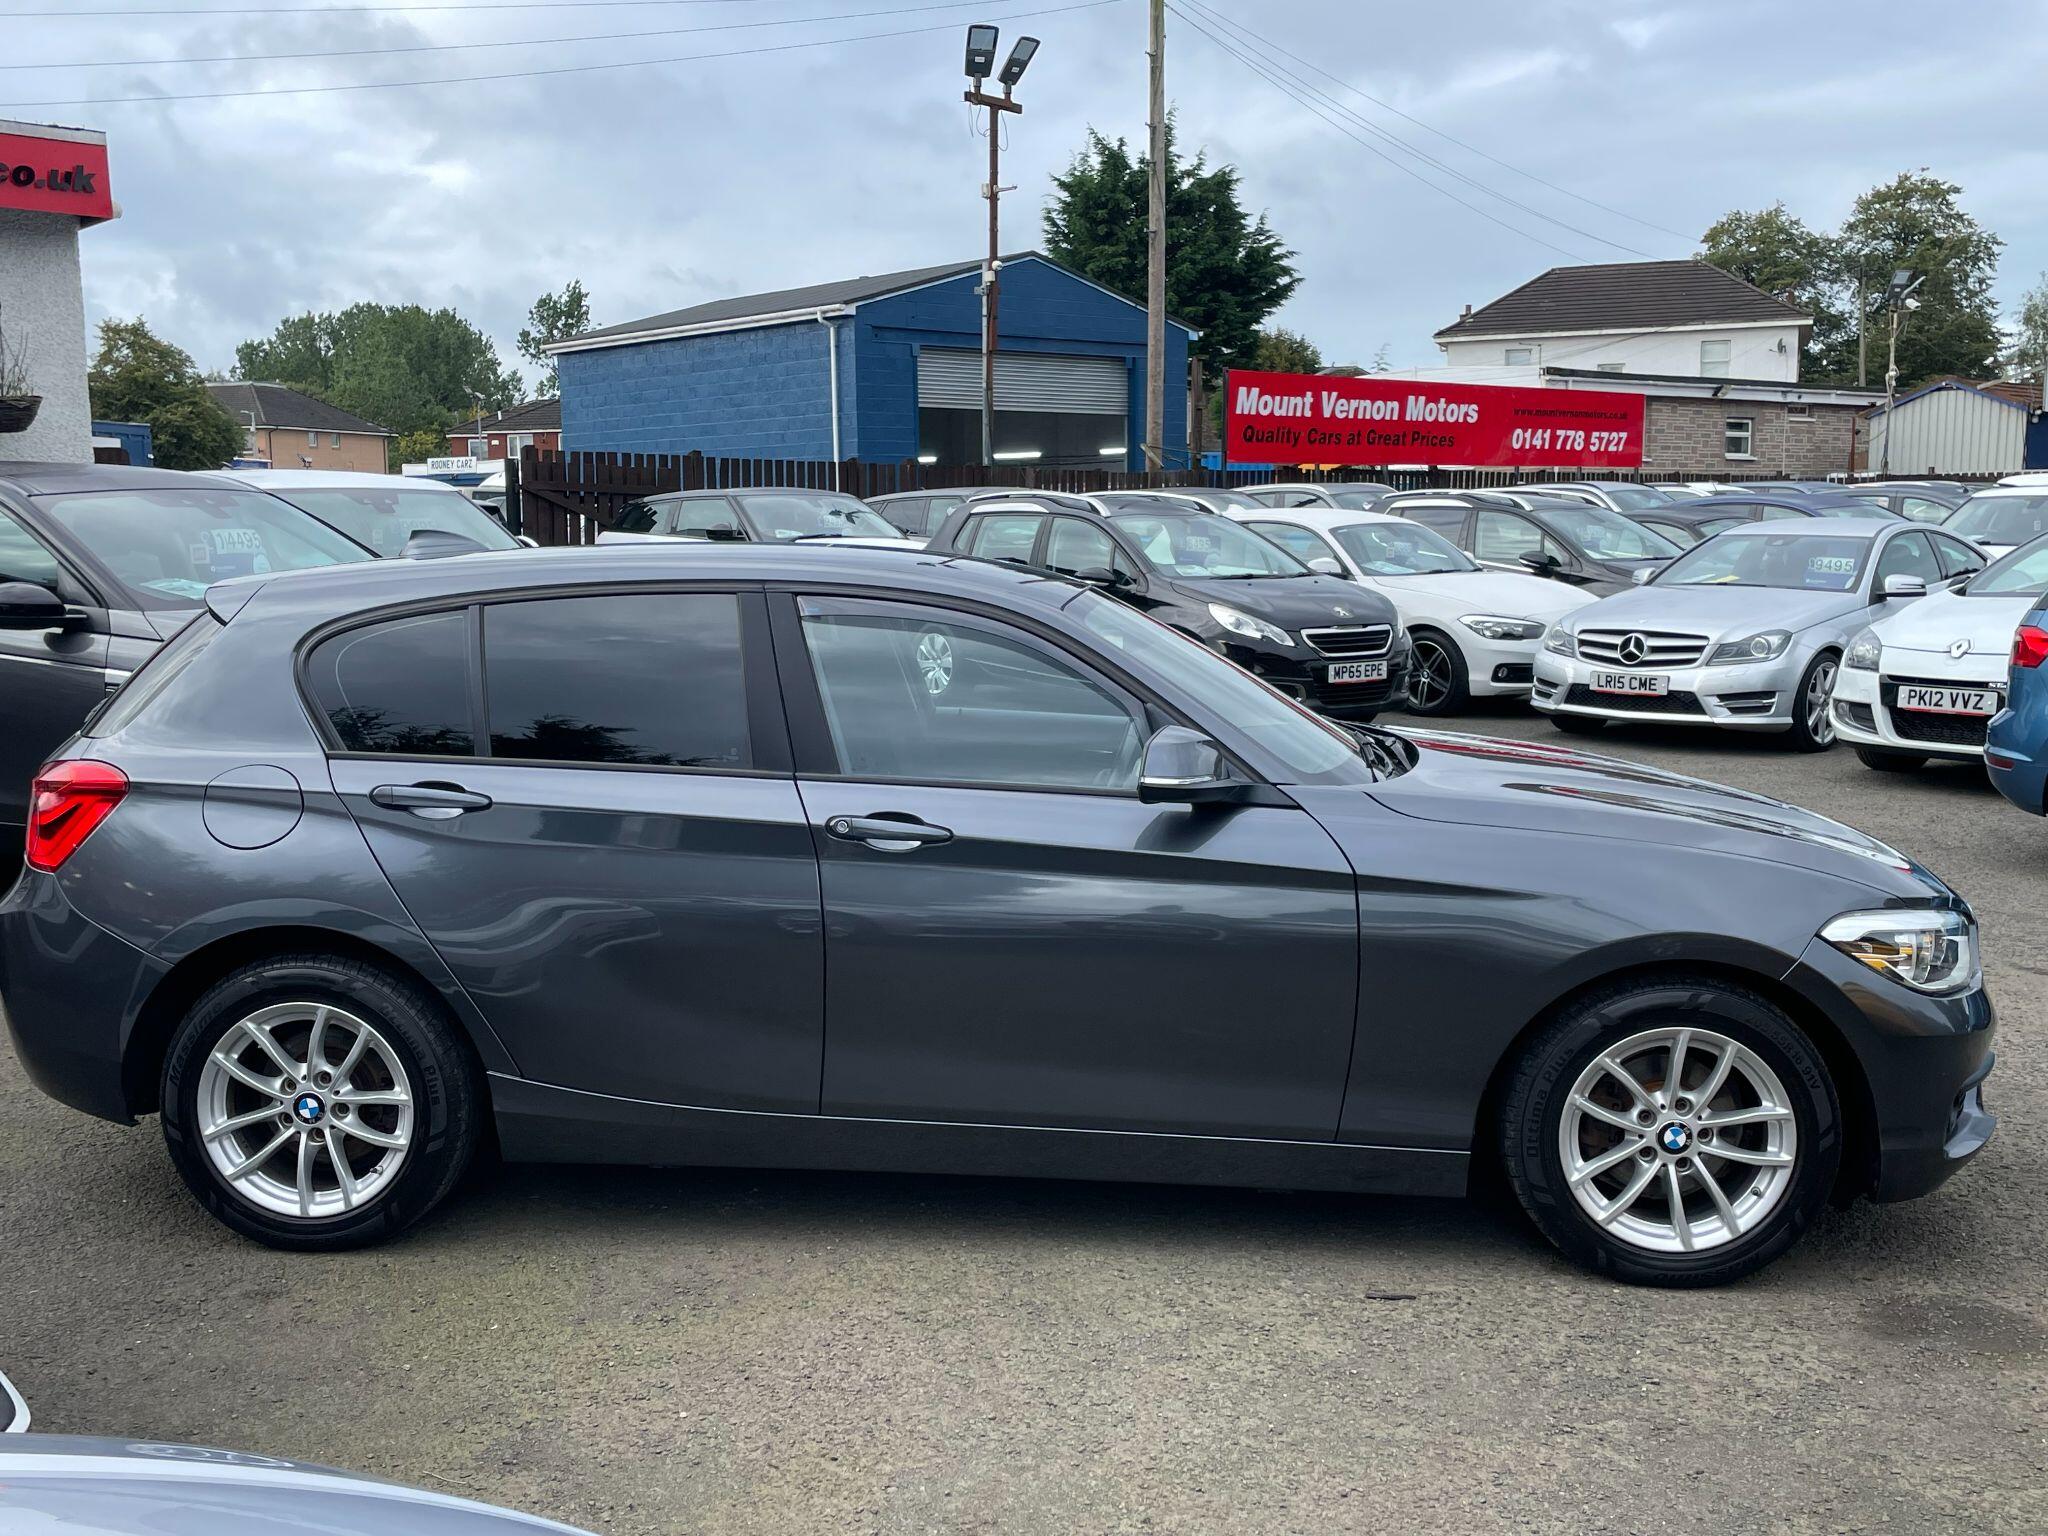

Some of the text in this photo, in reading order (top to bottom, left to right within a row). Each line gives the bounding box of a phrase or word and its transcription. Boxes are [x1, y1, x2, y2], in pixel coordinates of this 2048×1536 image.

[1235, 386, 1479, 424] Mount Vernon Motors
[1242, 425, 1455, 448] Quality Cars at Great Prices
[1511, 428, 1628, 452] 0141 778 5727
[431, 458, 473, 470] ROONEY CARZ
[1333, 662, 1384, 680] MP65 EPE
[1597, 674, 1658, 692] LR15 CME
[1907, 688, 1985, 711] PK12 VVZ
[1543, 1048, 1574, 1083] Plus
[424, 1065, 440, 1106] Plus
